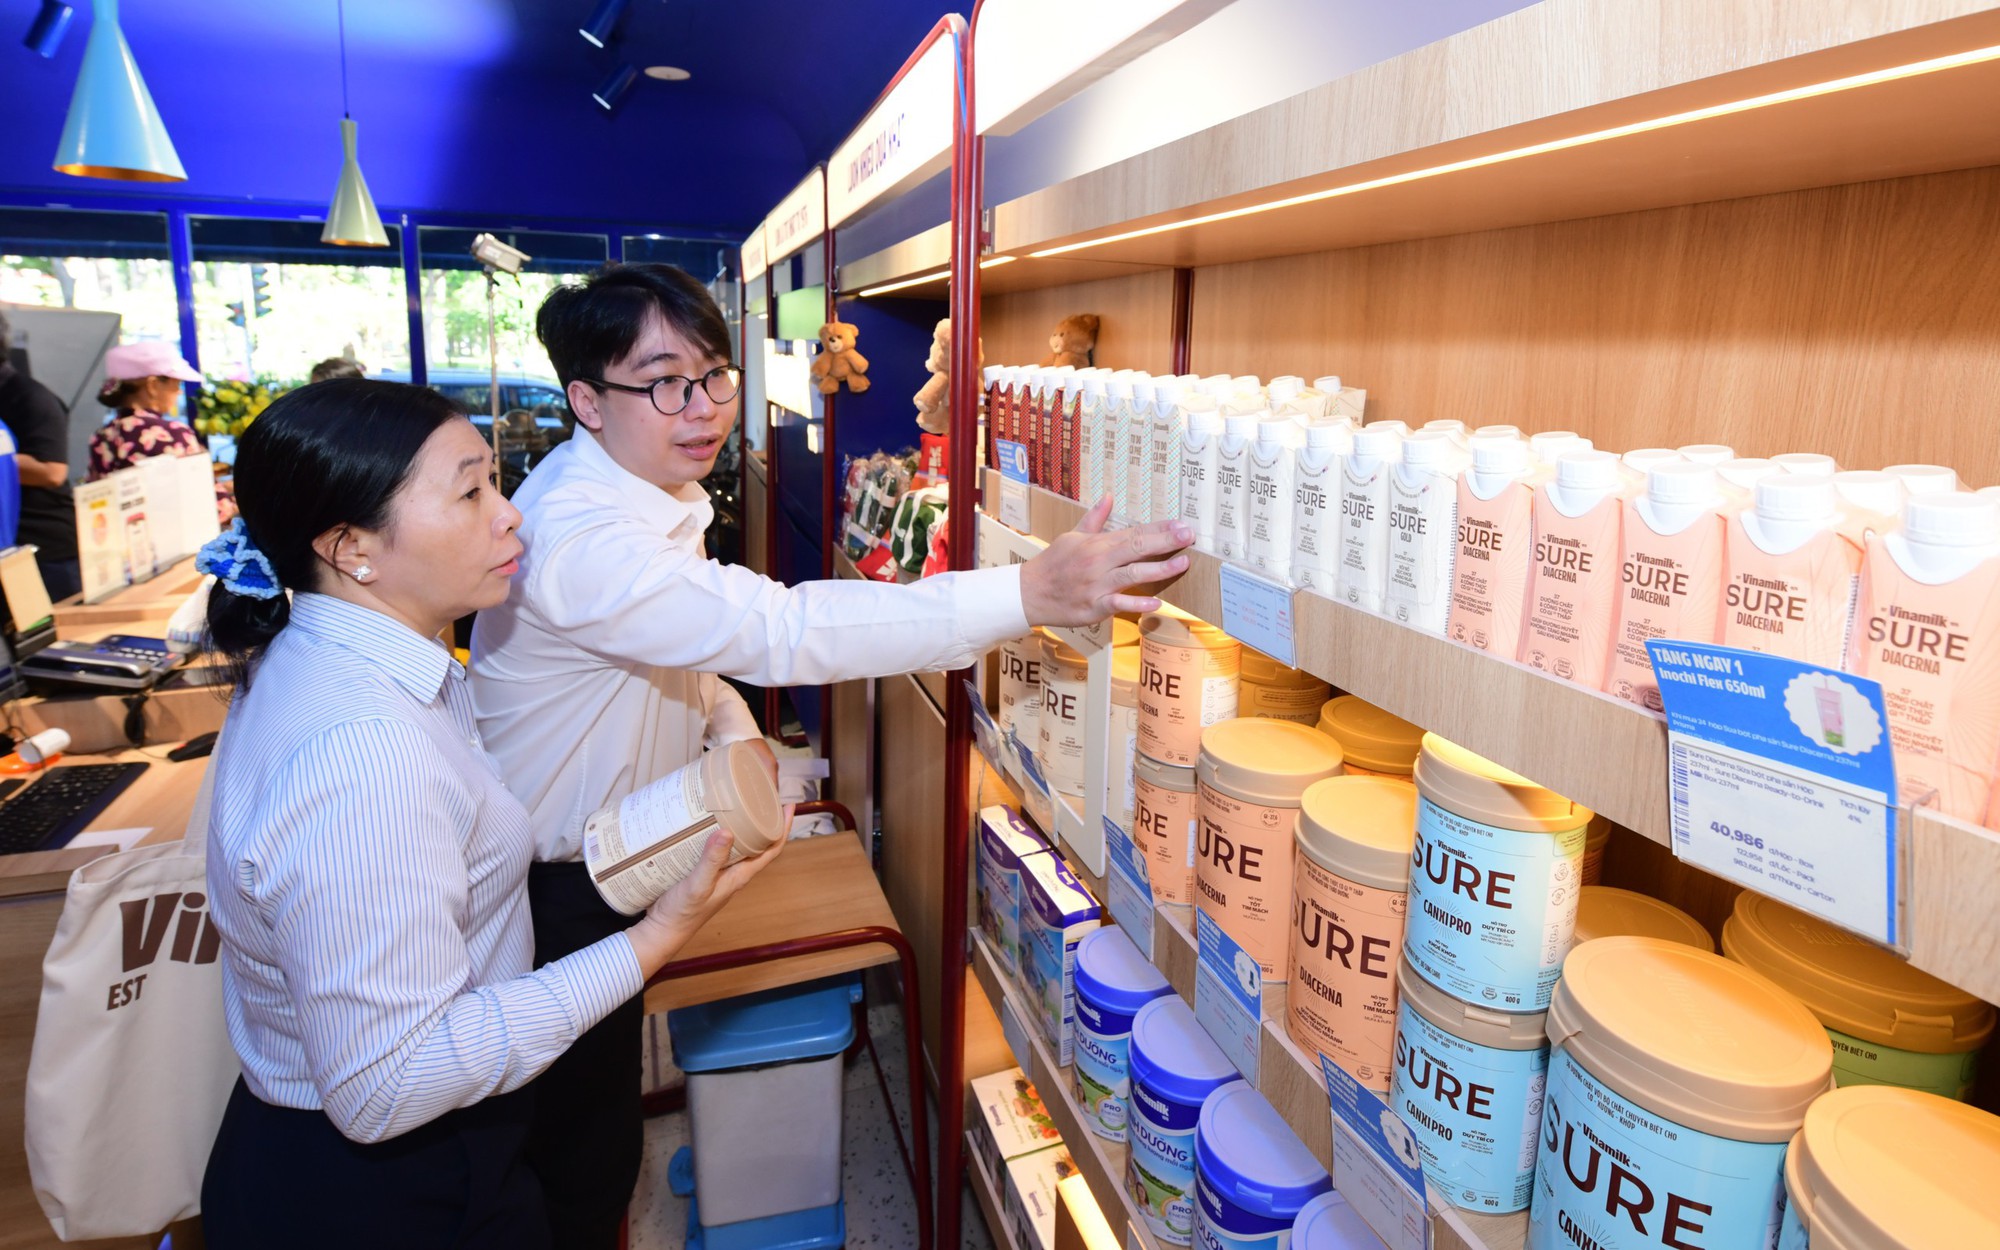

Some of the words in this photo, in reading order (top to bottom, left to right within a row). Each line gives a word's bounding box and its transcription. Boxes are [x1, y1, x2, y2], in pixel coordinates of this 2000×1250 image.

[1182, 465, 1206, 480] SURE
[1218, 472, 1242, 488] SURE
[1250, 480, 1278, 498] SURE
[1296, 490, 1326, 509] SURE
[1304, 507, 1314, 516] GOLD
[1342, 500, 1374, 520] SURE
[1350, 518, 1361, 528] GOLD
[1390, 511, 1426, 534] SURE
[1466, 516, 1492, 529] Vinamilk
[1401, 532, 1412, 542] GOLD
[1458, 525, 1503, 551] SURE
[1547, 534, 1580, 549] Vinamilk
[1464, 546, 1490, 561] DIACERNA
[1536, 543, 1592, 573] SURE
[1636, 552, 1674, 569] Vinamilk
[1543, 566, 1577, 584] DIACERNA
[1622, 562, 1689, 596] SURE
[1743, 573, 1788, 592] Vinamilk
[1631, 588, 1670, 608] DIACERNA
[1726, 584, 1807, 621] SURE
[1736, 612, 1784, 634] DIACERNA
[1890, 605, 1948, 628] Vinamilk
[1868, 617, 1969, 662] SURE
[1001, 652, 1040, 684] URE
[1652, 648, 1692, 667] TẶNG
[1692, 653, 1732, 674] NGAY
[1734, 660, 1744, 676] 1
[1882, 648, 1940, 675] DIACERNA
[1140, 666, 1181, 699] URE
[1659, 668, 1697, 685] Inochi
[1698, 674, 1724, 690] Flex
[1724, 678, 1766, 699] 650ml
[1040, 685, 1076, 720] URE
[1705, 755, 1736, 770] Diacerna
[1690, 760, 1710, 771] 237ml
[1732, 774, 1763, 789] Diacerna
[1718, 778, 1740, 790] 237ml
[1134, 802, 1168, 838] URE
[1198, 817, 1263, 882] URE
[1438, 840, 1466, 860] Vinamilk
[1413, 831, 1515, 909] SURE
[1808, 887, 1836, 904] Carton
[1310, 898, 1338, 922] Vinamilk
[1293, 889, 1391, 979] SURE
[1482, 924, 1496, 932] DUY
[107, 974, 147, 1011] EST
[1300, 966, 1342, 1008] DIACERNA
[1363, 1004, 1376, 1012] TIM
[1505, 996, 1516, 1004] 400
[1420, 1046, 1448, 1070] Vinamilk
[1865, 1051, 1878, 1061] CHO
[1396, 1030, 1494, 1120] SURE
[1104, 1102, 1121, 1113] PRO
[1462, 1132, 1475, 1140] DUY
[1626, 1110, 1648, 1128] CHUYÊN
[1649, 1122, 1662, 1136] BIỆT
[1664, 1130, 1678, 1141] CHO
[1140, 1128, 1188, 1162] DƯỠNG
[1583, 1122, 1630, 1168] Vinamilk
[1544, 1093, 1713, 1250] SURE
[1172, 1204, 1192, 1214] PRO
